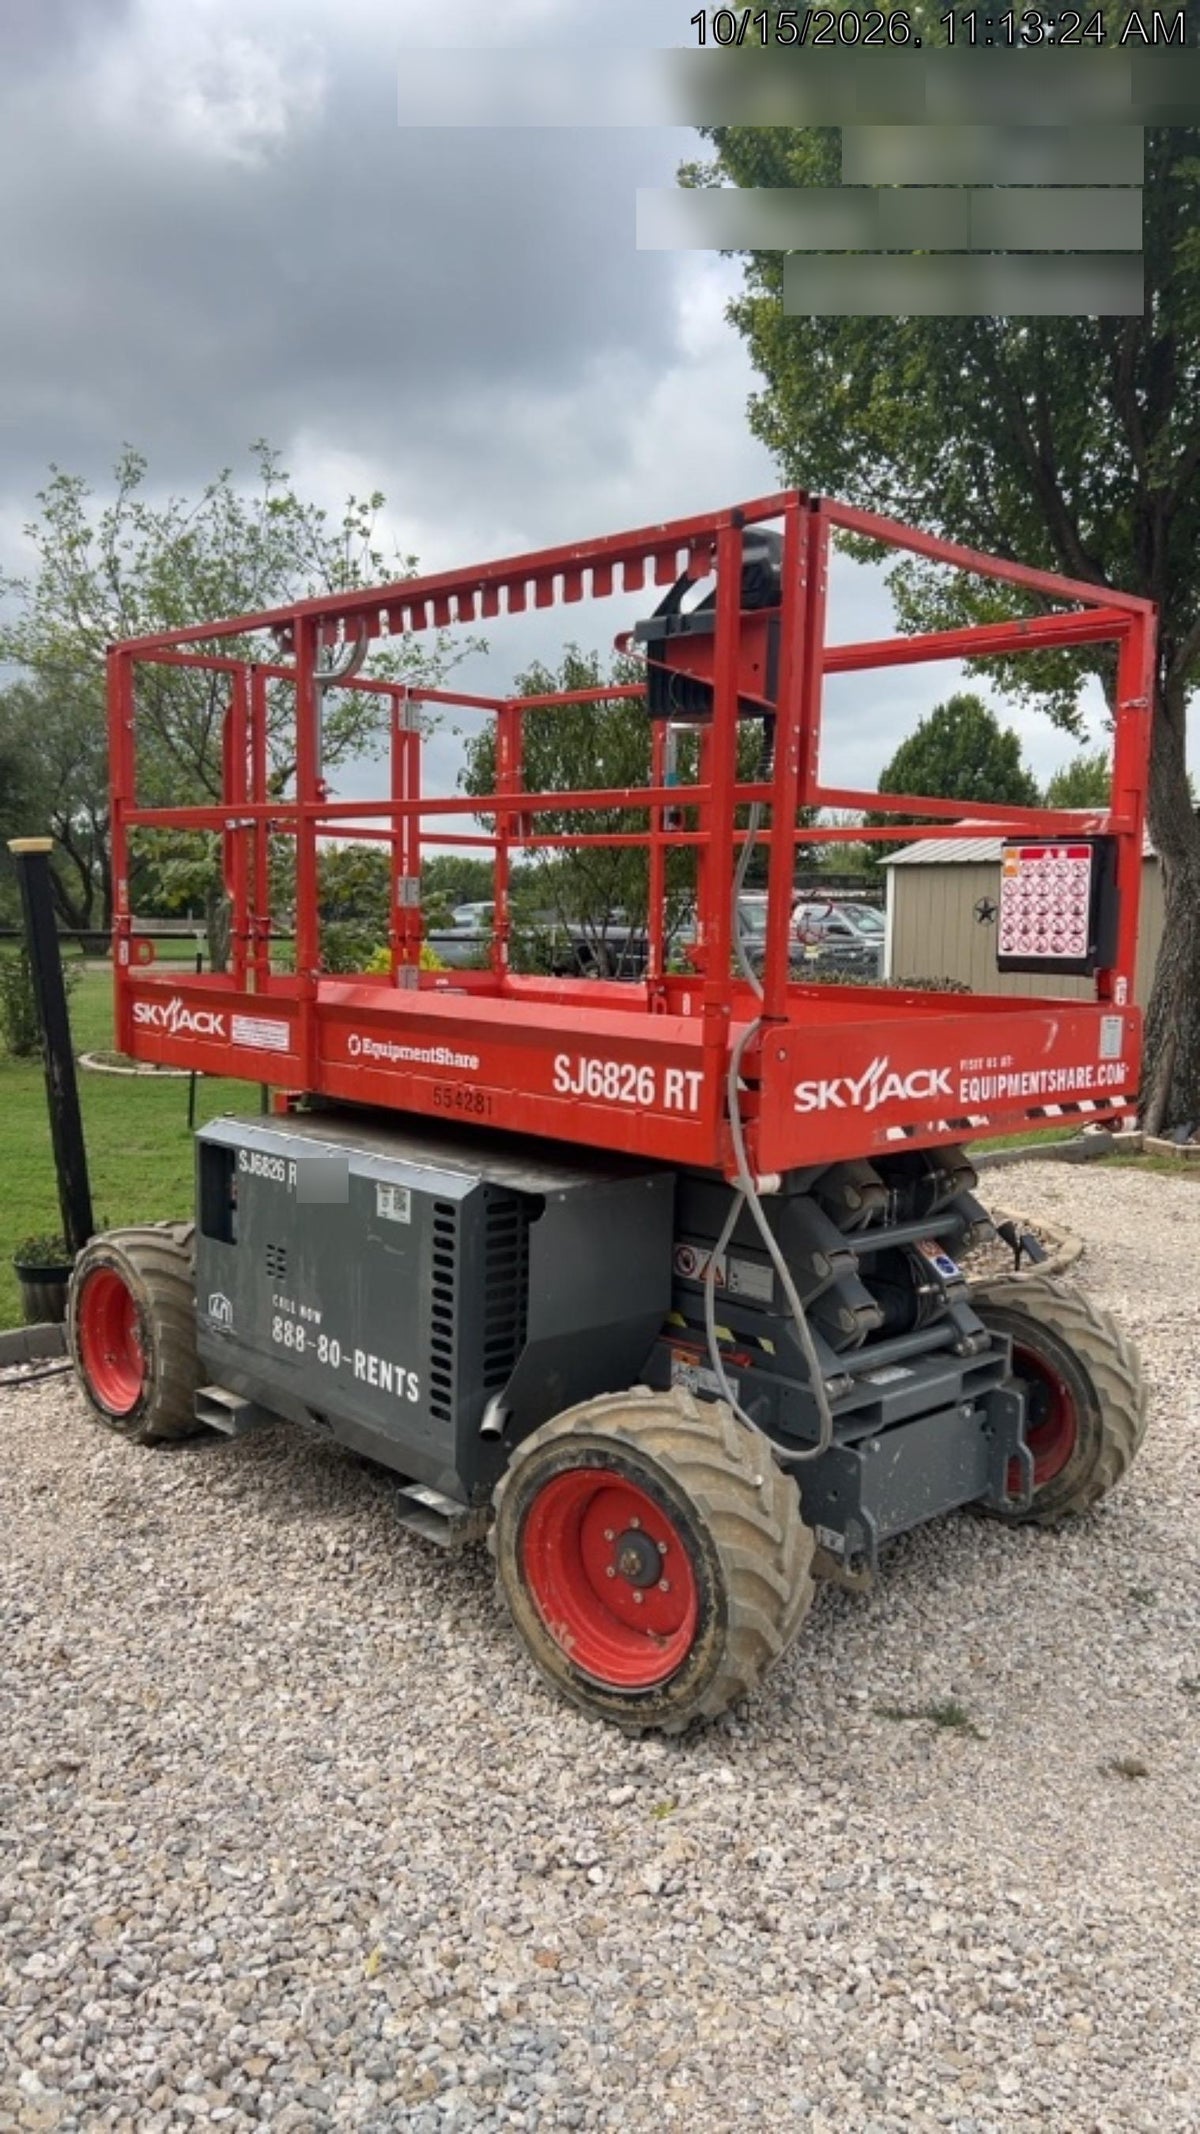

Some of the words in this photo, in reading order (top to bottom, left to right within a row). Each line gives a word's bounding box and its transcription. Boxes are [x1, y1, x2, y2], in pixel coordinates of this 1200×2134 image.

[132, 996, 226, 1036] SKYJACK
[362, 1037, 479, 1070] EquipmentShare
[986, 1056, 997, 1069] US
[553, 1053, 656, 1106] SJ6826
[663, 1067, 704, 1112] RT
[793, 1055, 954, 1113] SKYJACK
[959, 1062, 1126, 1104] EQUIPMENTSHARE.COM
[238, 1149, 286, 1183] SJ6826
[272, 1294, 297, 1315] CALL
[300, 1305, 322, 1325] NOW
[271, 1315, 419, 1402] 888-80-RENTS
